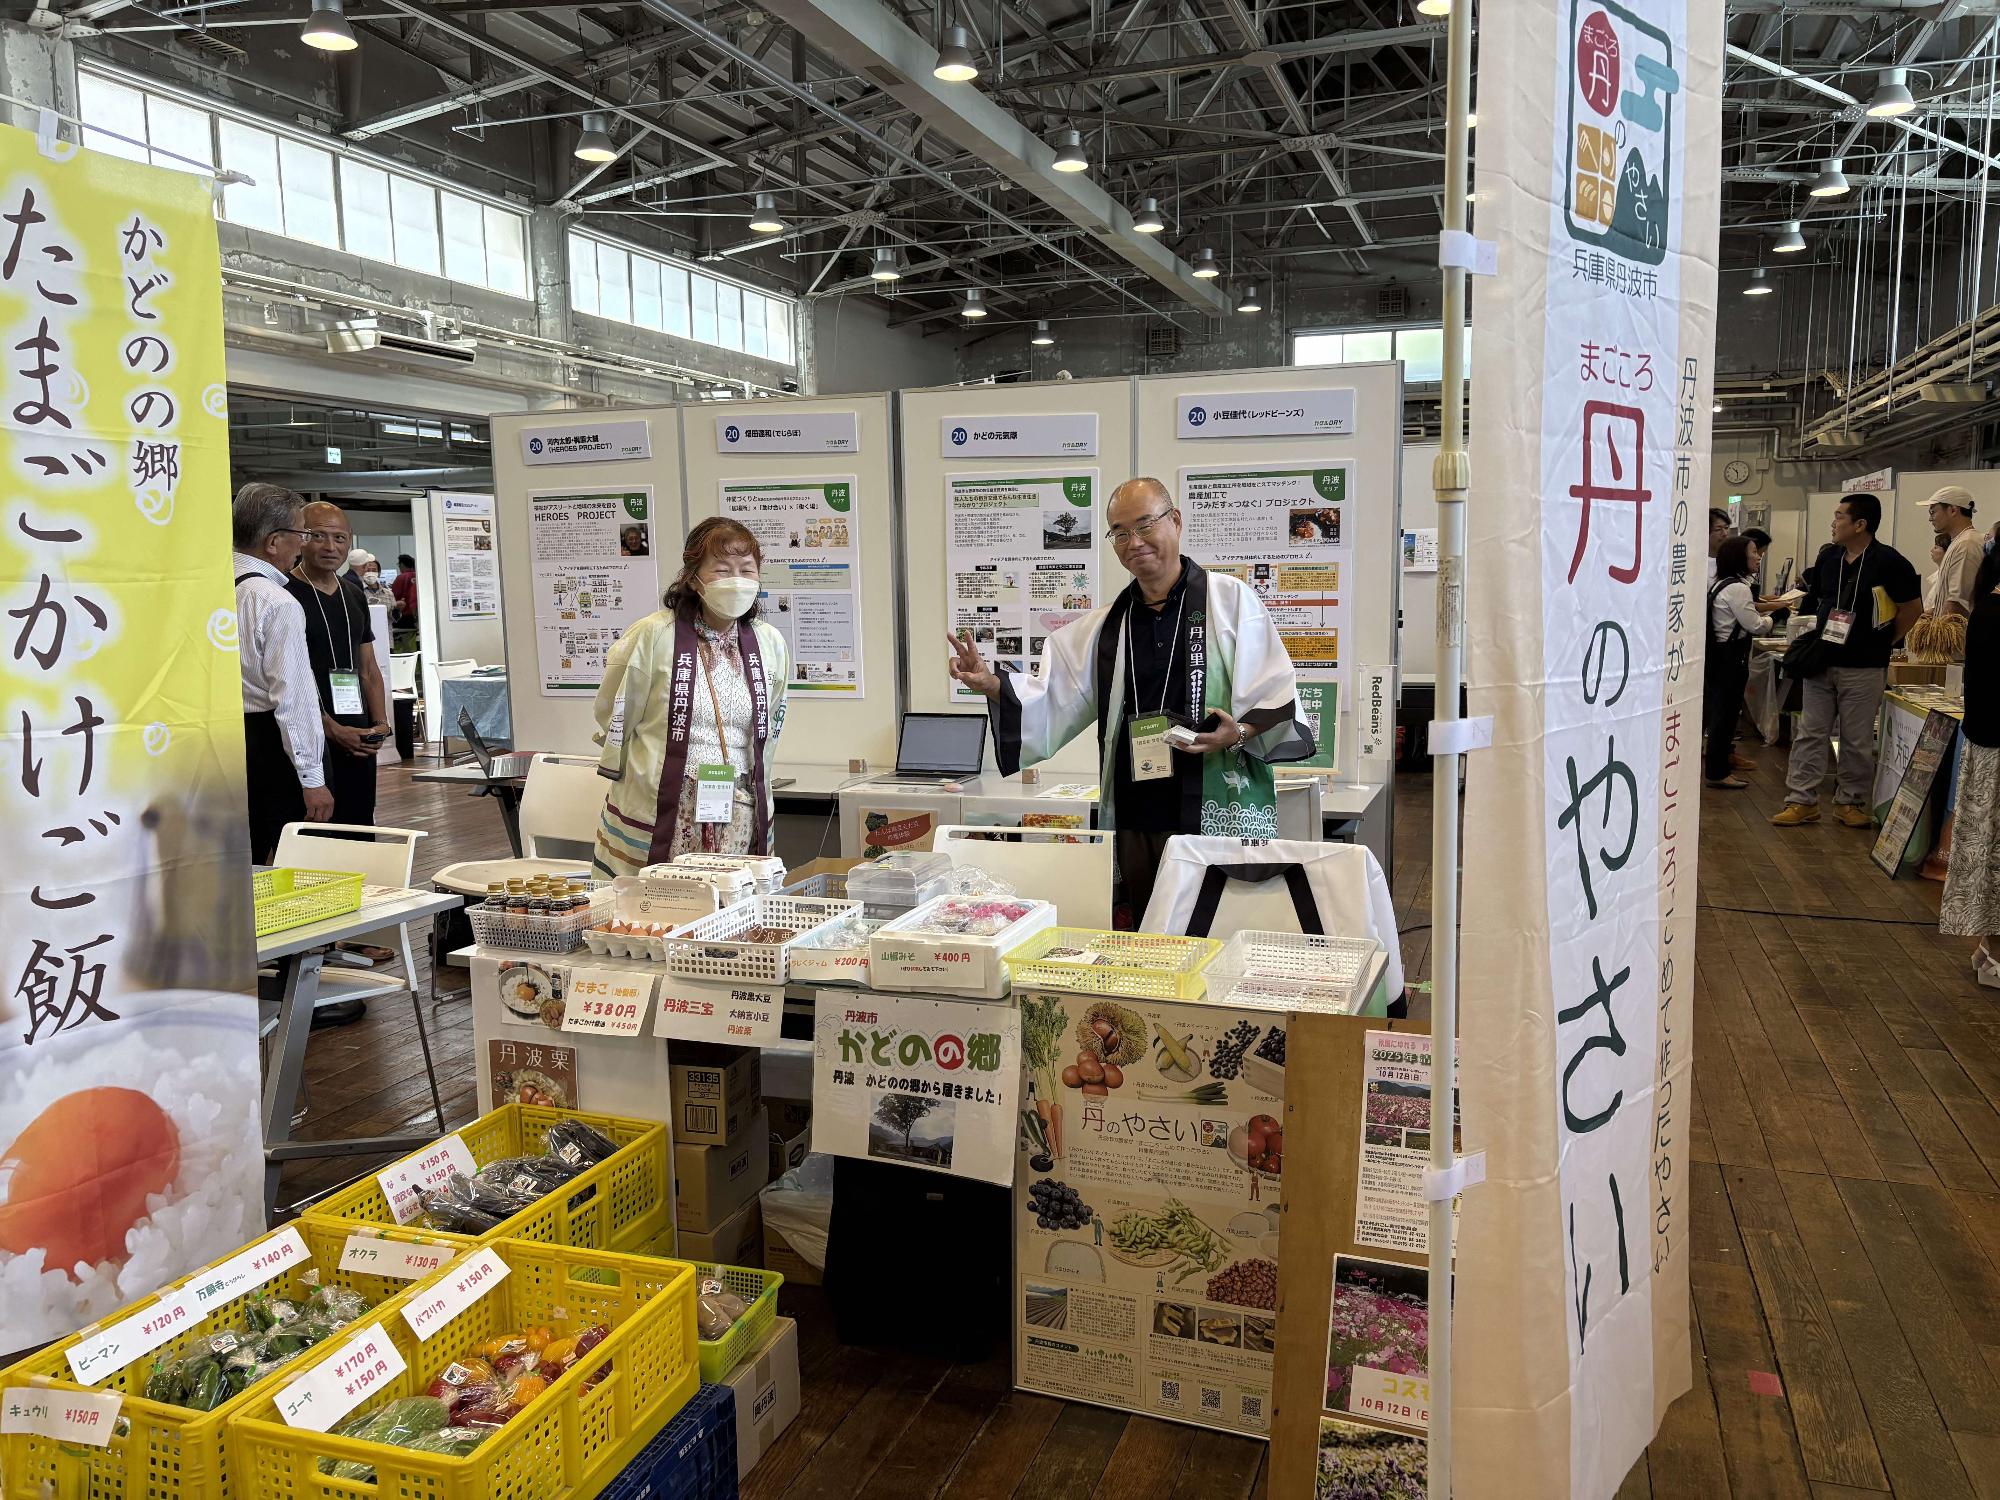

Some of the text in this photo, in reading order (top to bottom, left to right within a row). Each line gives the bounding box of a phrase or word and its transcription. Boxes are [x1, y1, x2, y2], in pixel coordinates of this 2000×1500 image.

[1587, 51, 1612, 108] 丹
[1615, 120, 1626, 149] の
[1626, 161, 1661, 248] やさい
[1572, 247, 1658, 300] 兵庫県丹波市
[122, 216, 179, 493] かどのの郷
[1580, 340, 1652, 391] まごころ
[1190, 412, 1204, 423] 20
[727, 429, 739, 439] 20
[953, 431, 1018, 442] 20 かどの元気隊
[530, 442, 542, 451] 20
[579, 443, 612, 452] PROJECT)
[1071, 483, 1086, 492] 丹波
[1322, 475, 1341, 485] 丹波
[832, 489, 846, 498] 丹波
[535, 511, 616, 522] HEROES PROJECT
[2, 187, 121, 1048] たまごかけご飯
[1190, 626, 1205, 667] 丹の里
[671, 653, 693, 742] 兵庫県丹波市
[749, 653, 768, 739] 兵庫県丹波市
[1371, 676, 1382, 735] RedBeans
[1558, 400, 1652, 1355] 丹のやさい
[575, 981, 609, 995] たまご
[731, 991, 772, 1004] 丹波黒大豆
[584, 1001, 638, 1018] ¥380円
[664, 998, 715, 1017] 丹波三宝
[729, 1009, 770, 1022] 大納言小豆
[845, 1010, 878, 1024] 丹波市
[611, 1022, 638, 1031] ¥450円
[727, 1025, 753, 1036] 丹波栗
[500, 1043, 569, 1072] 丹波栗
[837, 1029, 1002, 1072] かどのの郷
[688, 1073, 719, 1083] 33135
[833, 1069, 1002, 1106] 丹波 かどのの郷から届きました!
[1082, 1107, 1198, 1142] 丹のやさい
[420, 1150, 450, 1171] ¥150円
[386, 1173, 407, 1190] なす
[425, 1163, 456, 1185] ¥150円
[252, 1242, 294, 1270] ¥140円
[349, 1246, 439, 1270] オクラ ¥130円
[414, 1263, 493, 1328] パプリカ ¥150円
[78, 1305, 186, 1371] ピーマン ¥120円
[334, 1342, 378, 1378] ¥170円
[344, 1360, 389, 1396] ¥150円
[9, 1404, 99, 1426] キュウリ ¥150円
[287, 1391, 313, 1417] ゴーヤ
